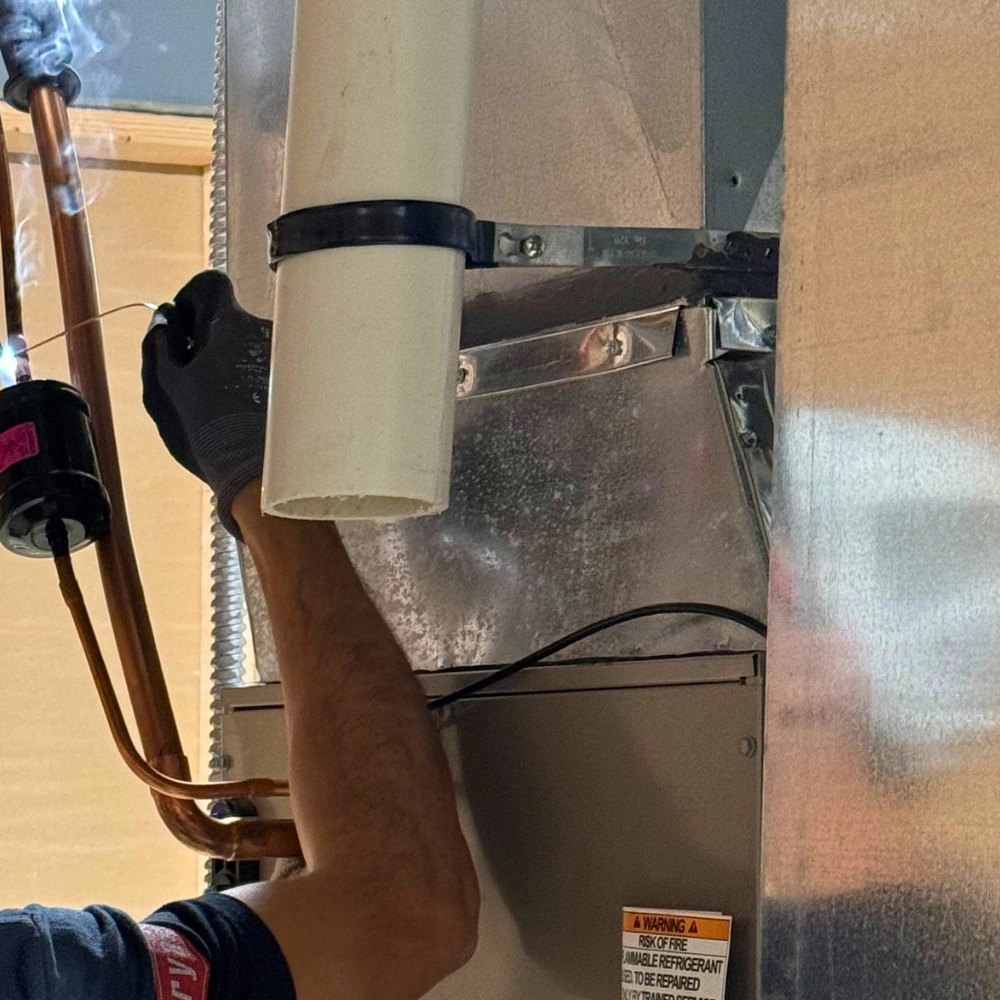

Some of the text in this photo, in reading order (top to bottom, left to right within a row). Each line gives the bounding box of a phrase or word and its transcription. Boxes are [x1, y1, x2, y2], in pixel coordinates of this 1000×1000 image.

[643, 915, 685, 933] WARNING
[638, 935, 688, 951] RISK OF FIRE
[659, 955, 723, 974] REFRIGERANT
[634, 971, 644, 985] TO
[644, 972, 656, 986] BE
[656, 974, 700, 991] REPAIRED
